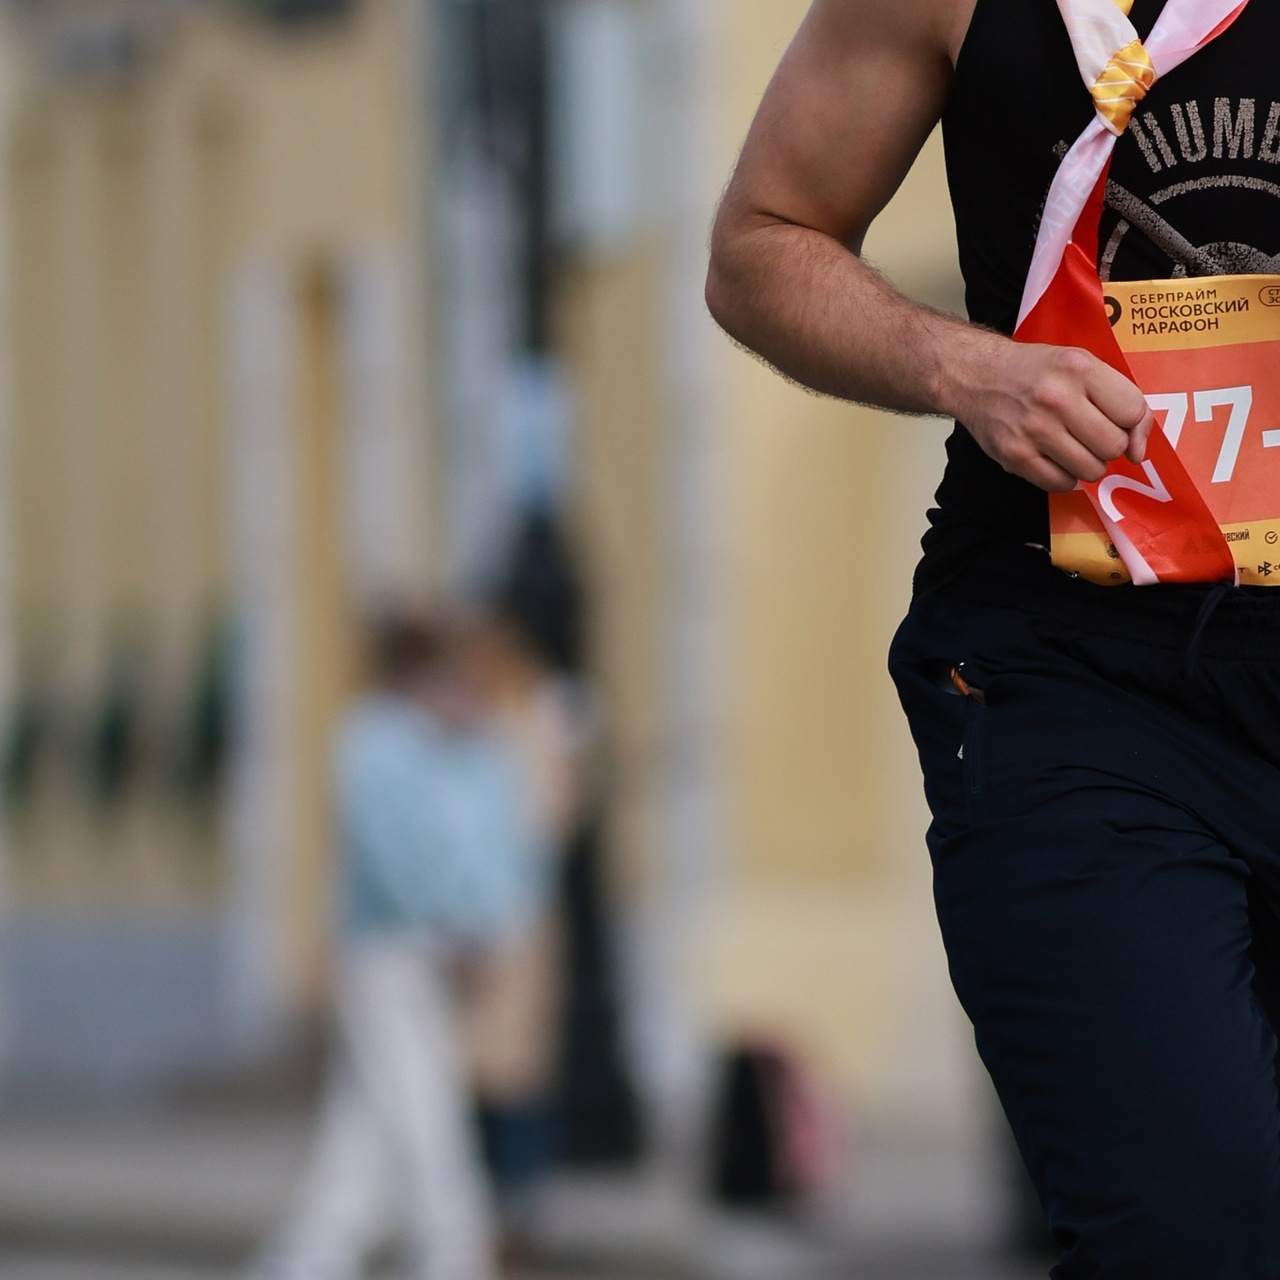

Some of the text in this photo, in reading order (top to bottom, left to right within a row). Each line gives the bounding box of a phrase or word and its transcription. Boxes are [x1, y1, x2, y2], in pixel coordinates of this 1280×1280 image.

[1130, 289, 1217, 304] СБЕРПРАЙМ
[1131, 296, 1249, 320] МОСКОВСКИЙ
[1132, 317, 1219, 335] МАРАФОН
